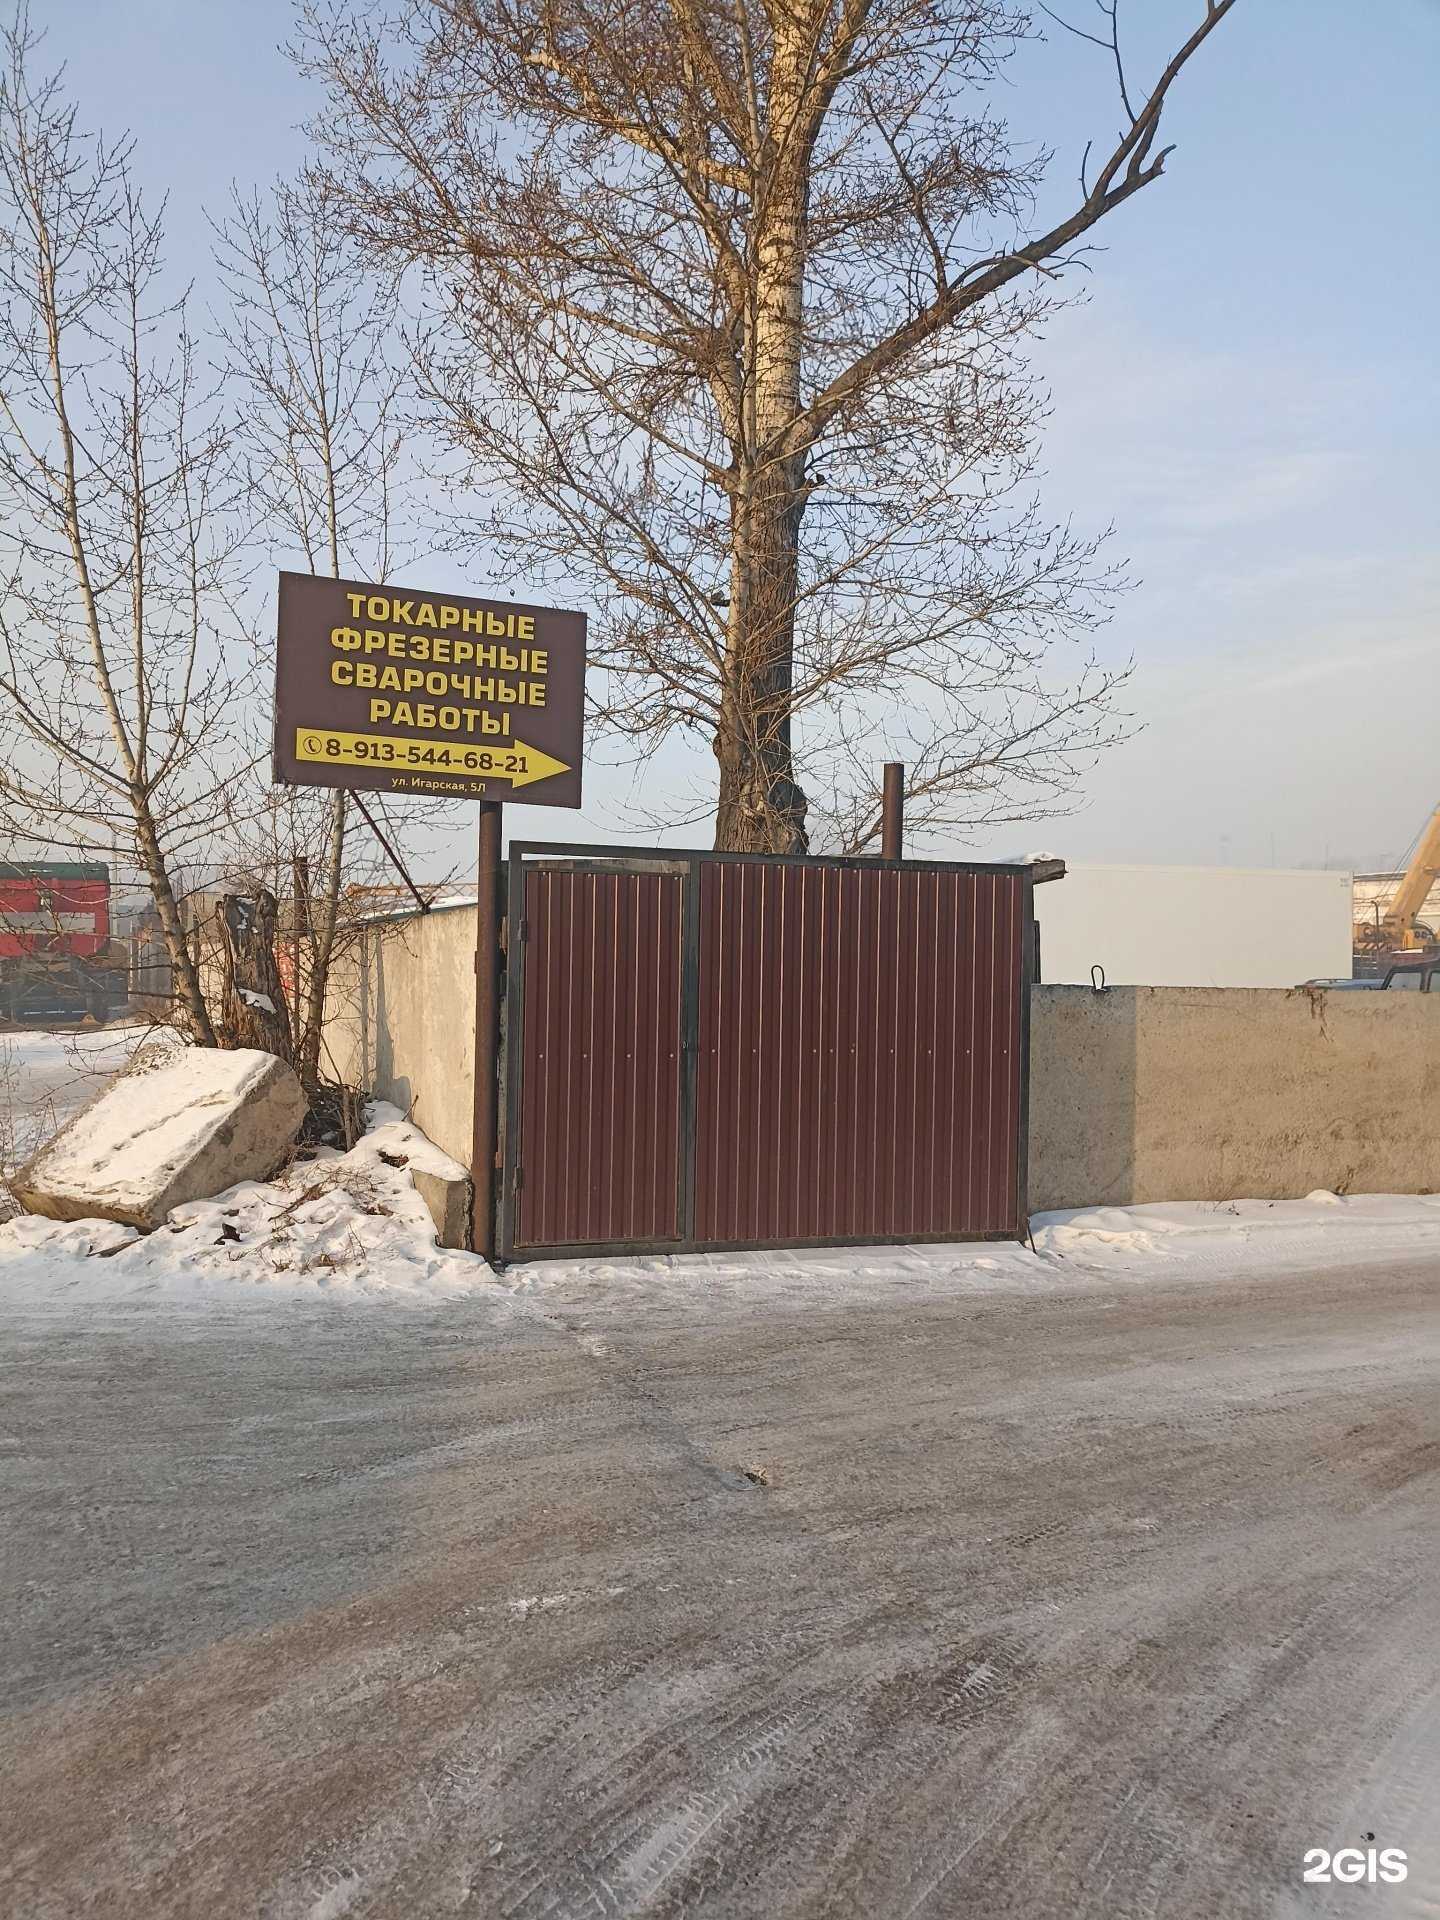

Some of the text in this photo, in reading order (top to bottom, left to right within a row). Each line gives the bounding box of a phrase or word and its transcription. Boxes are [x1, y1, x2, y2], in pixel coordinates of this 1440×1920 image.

[347, 593, 535, 640] ТОКАРНЫЕ
[331, 626, 548, 674] ФРЕЗЕРНЫЕ
[331, 660, 546, 707] СВАРОЧНЫЕ
[369, 698, 510, 736] РАБОТЫ
[325, 738, 529, 774] 8-913-544-68-21
[391, 778, 408, 788] ул.
[411, 777, 468, 792] Игарская,
